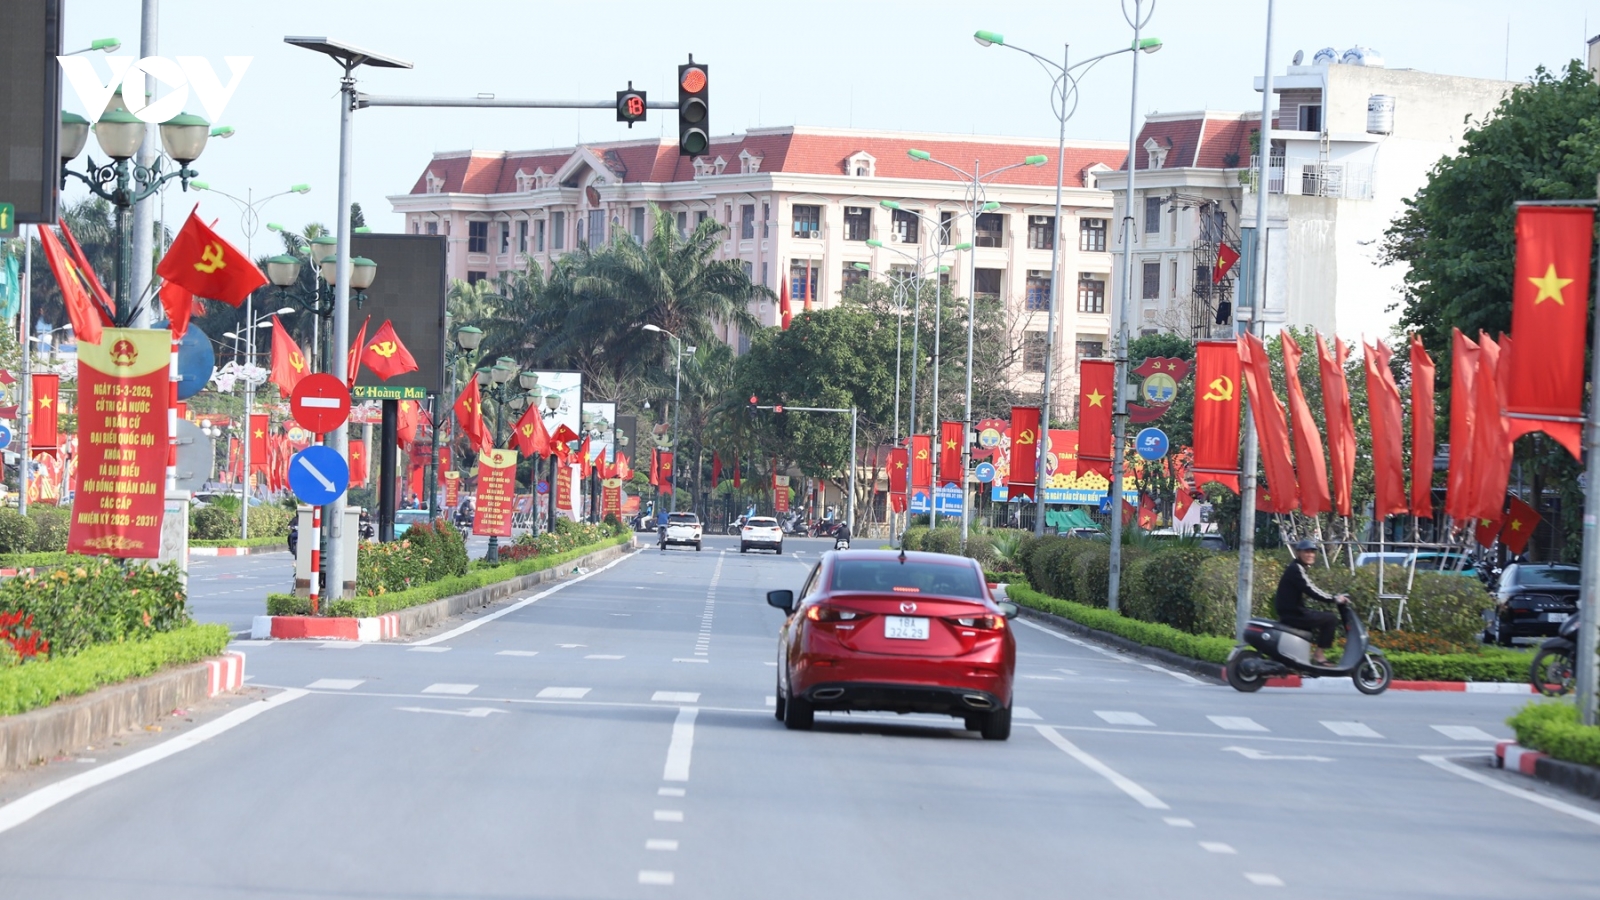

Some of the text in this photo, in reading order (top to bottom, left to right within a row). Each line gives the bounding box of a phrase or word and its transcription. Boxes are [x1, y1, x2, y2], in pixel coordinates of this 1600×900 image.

[627, 97, 643, 116] 18
[93, 382, 153, 398] NGÀY 15-3-2026,
[366, 386, 401, 400] Hoàng
[96, 397, 151, 413] CỬ TRI CẢ NƯỚC
[105, 413, 141, 429] ĐI BẦU CỬ
[90, 429, 154, 448] ĐẠI BIỂU QUỐC HỘI
[104, 447, 136, 461] KHÓA XVI
[99, 462, 140, 478] VÀ ĐẠI BIỂU
[83, 477, 157, 495] HỘI ĐỒNG NHÂN DÂN
[100, 494, 132, 510] CÁC CẤP
[78, 511, 99, 526] NHIỆM
[111, 514, 130, 526] 2026
[135, 515, 158, 527] 2031!
[890, 628, 923, 638] 324.29
